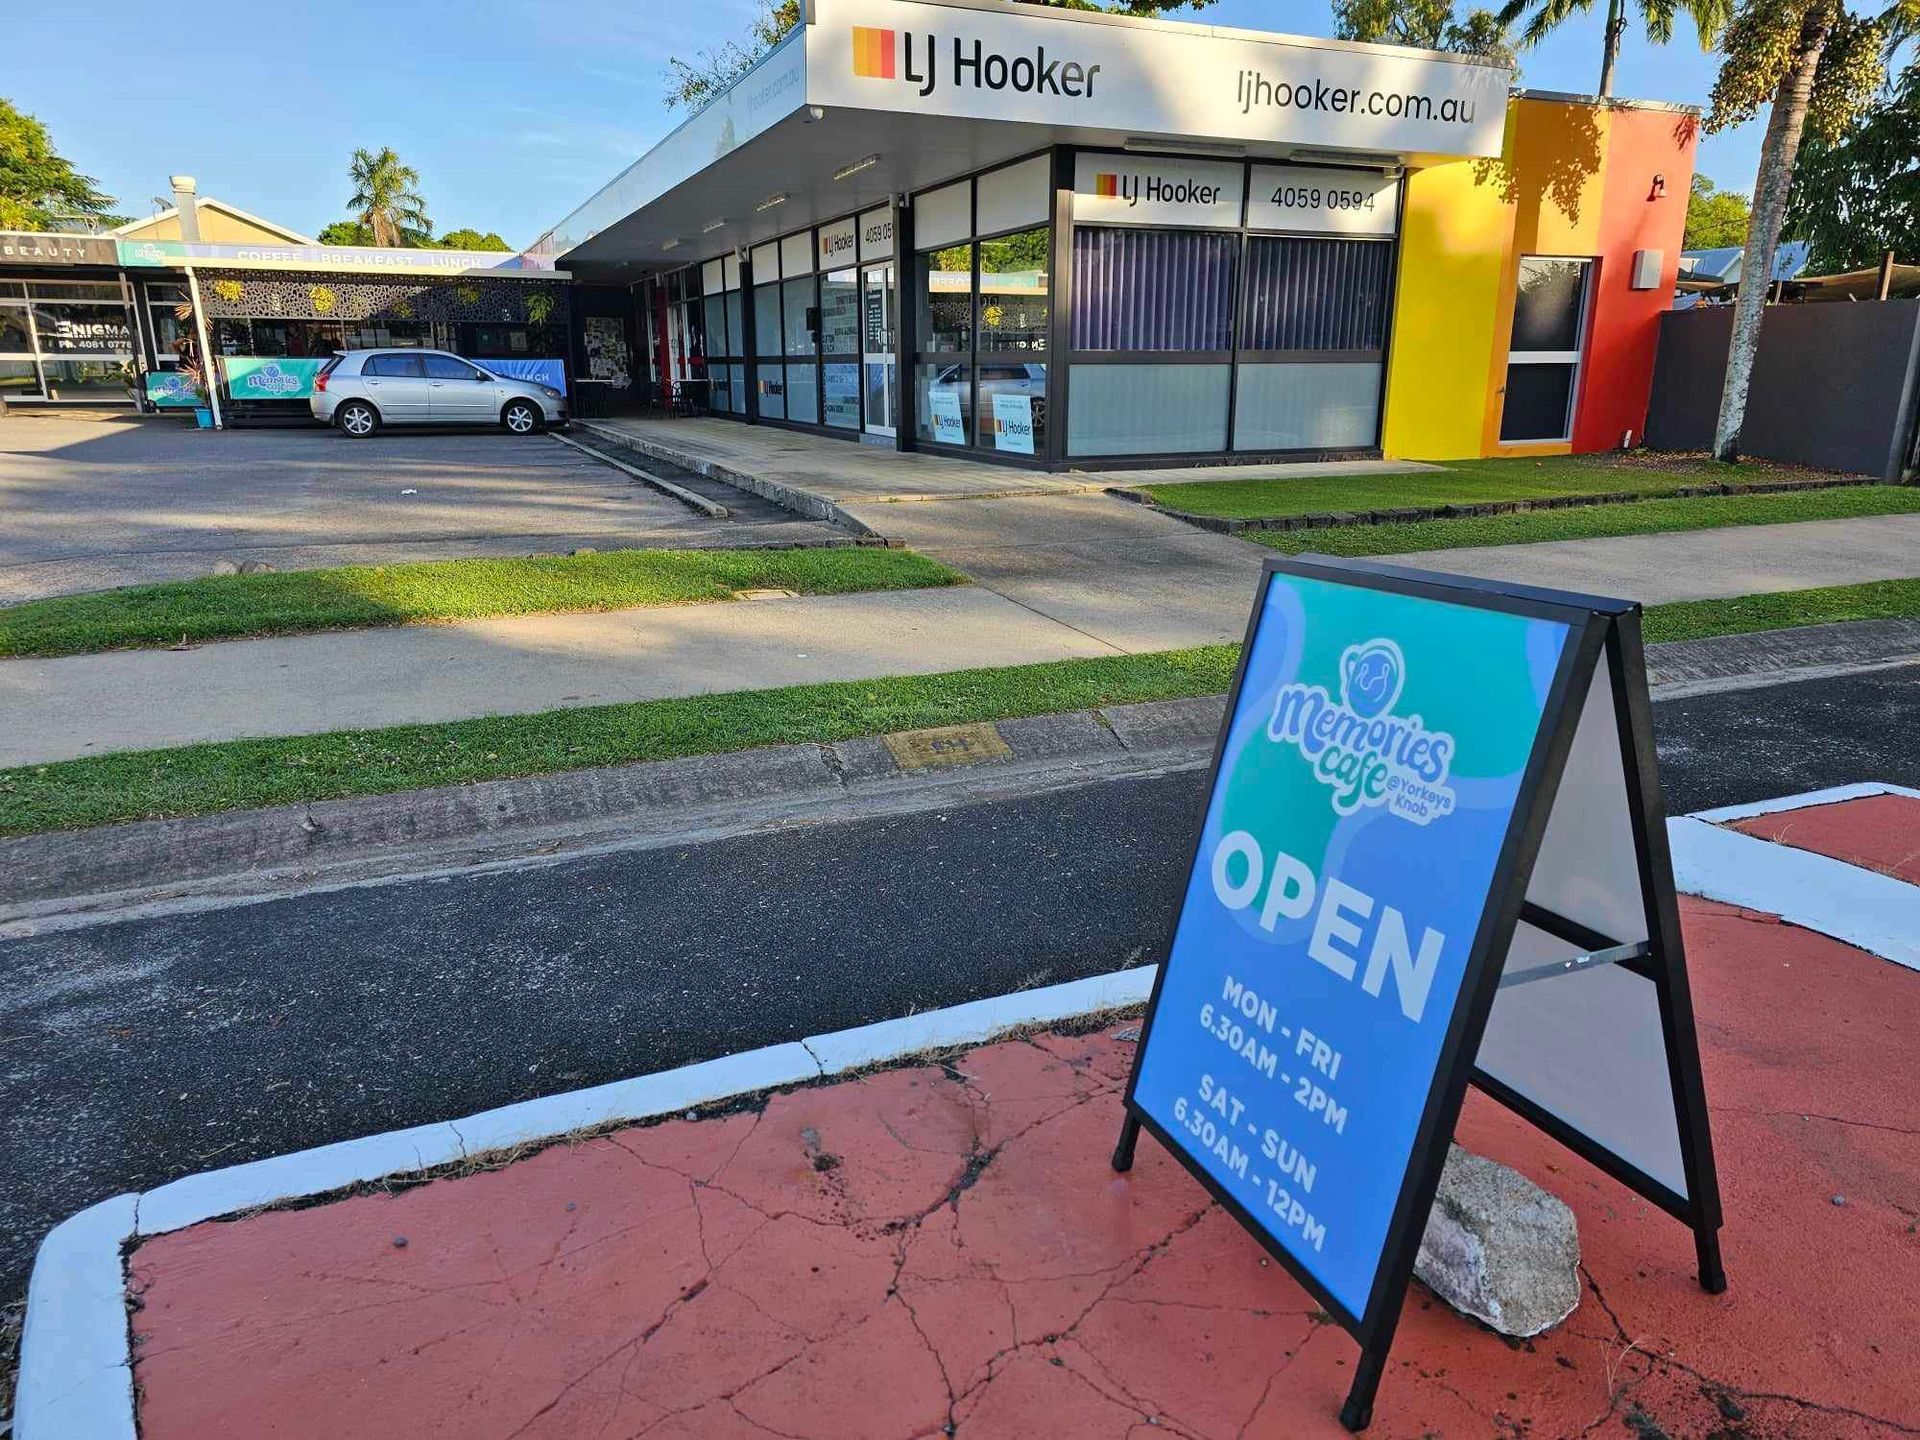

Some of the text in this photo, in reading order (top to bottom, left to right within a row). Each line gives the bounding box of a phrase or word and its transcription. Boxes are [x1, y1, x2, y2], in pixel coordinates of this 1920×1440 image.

[904, 31, 1101, 98] LJ Hooker
[1236, 69, 1476, 124] ljhooker.com.au
[1122, 174, 1220, 206] LJ Hooker
[1271, 186, 1376, 212] 4059 0594
[834, 232, 853, 252] Hooker
[865, 226, 881, 243] 4059
[4, 246, 85, 258] BEAUTY
[236, 250, 301, 262] COFFEE
[320, 253, 415, 267] BREAKFAST
[430, 256, 481, 269] LUNCH
[55, 320, 130, 338] ENIGMA
[79, 340, 104, 349] 4081
[1272, 690, 1449, 783] Memories
[1319, 747, 1452, 809] cafe @Yorkeys
[1396, 794, 1428, 817] Knob
[1211, 830, 1446, 1024] OPEN
[1222, 975, 1278, 1034] MON
[1296, 1028, 1342, 1081] FRI
[1200, 1004, 1278, 1080] 6.30AM
[1294, 1077, 1348, 1135] 2PM
[1198, 1074, 1246, 1127] SAT
[1261, 1129, 1317, 1194] SUN
[1174, 1097, 1249, 1180] 6.30AM
[1266, 1178, 1327, 1254] 12PM
